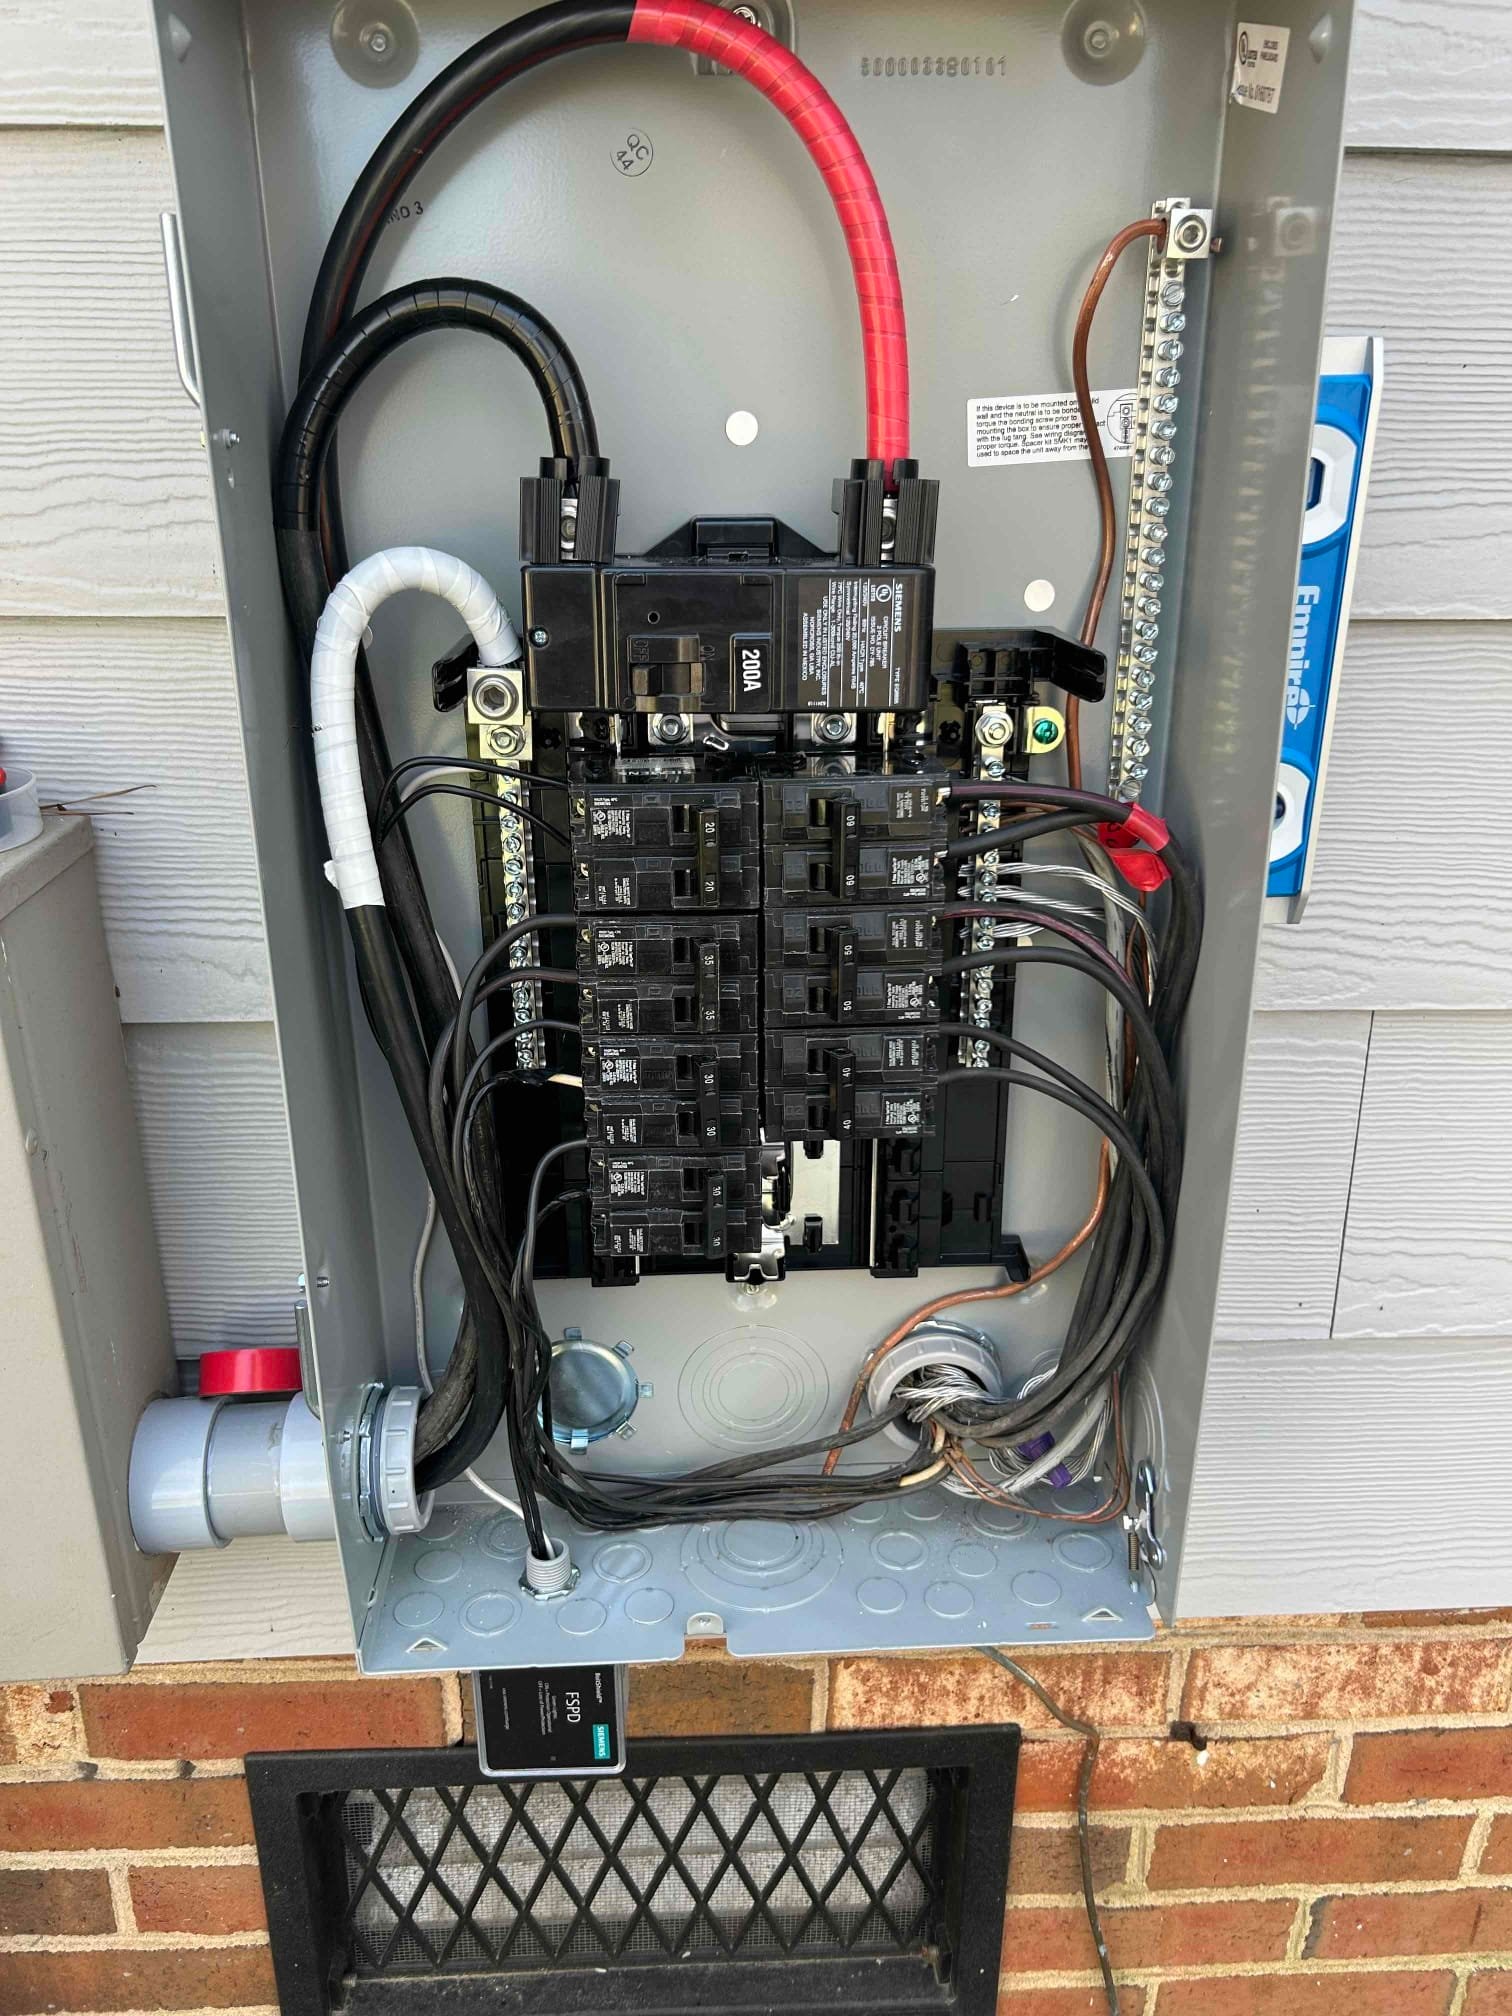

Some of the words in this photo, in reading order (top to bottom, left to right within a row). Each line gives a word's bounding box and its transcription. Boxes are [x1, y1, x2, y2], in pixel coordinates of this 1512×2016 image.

[627, 134, 649, 160] QC
[414, 201, 423, 215] 3
[995, 403, 1015, 411] device
[1040, 400, 1067, 408] mounted
[991, 411, 1002, 419] and
[1015, 409, 1036, 417] neutral
[1009, 417, 1034, 425] bonding
[1055, 415, 1070, 424] prior
[976, 427, 1005, 436] mounting
[1007, 426, 1016, 434] the
[1018, 425, 1029, 433] box
[1062, 422, 1081, 430] proper
[1002, 434, 1011, 442] lug
[1031, 431, 1043, 439] See
[1044, 430, 1063, 440] wiring
[1001, 449, 1020, 457] space
[1021, 447, 1031, 455] the
[894, 583, 903, 632] SIEMENS
[633, 640, 650, 661] OFF
[742, 649, 761, 692] 200A
[846, 815, 856, 827] 60
[704, 822, 716, 834] 20
[704, 881, 716, 892] 20
[845, 874, 855, 887] 60
[844, 944, 853, 956] 50
[704, 954, 714, 966] 35
[843, 1000, 853, 1012] 50
[705, 1010, 716, 1021] 35
[704, 1073, 714, 1085] 30
[842, 1067, 851, 1079] 40
[842, 1119, 852, 1131] 40
[706, 1126, 717, 1138] 30
[711, 1185, 721, 1197] 30
[712, 1236, 721, 1248] 30
[566, 1692, 581, 1722] FSPD
[598, 1726, 606, 1757] SIEMENS
